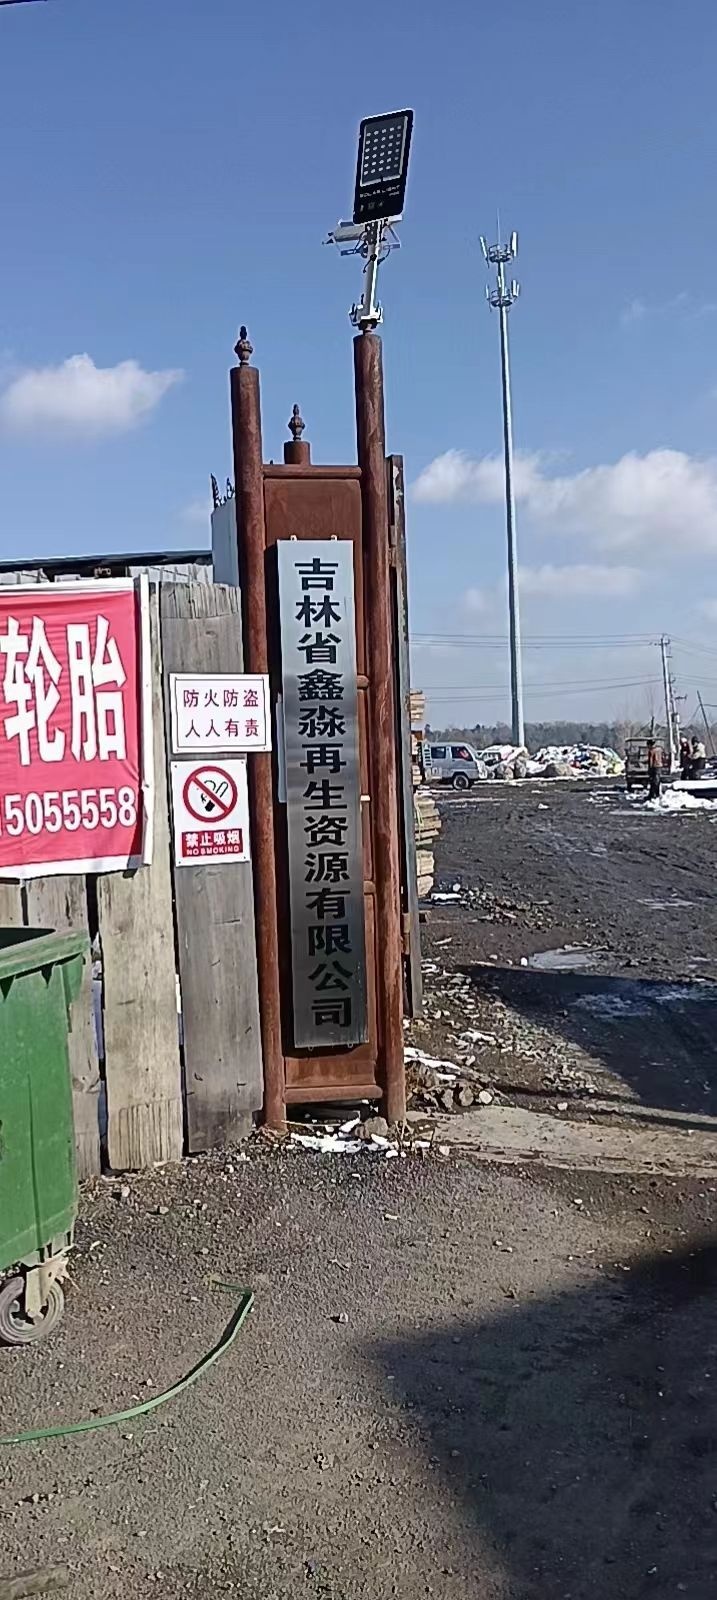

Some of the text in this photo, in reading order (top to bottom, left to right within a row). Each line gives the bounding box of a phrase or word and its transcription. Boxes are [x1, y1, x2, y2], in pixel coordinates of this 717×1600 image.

[0, 615, 127, 766] 轮胎
[183, 688, 259, 708] 防火防盗
[185, 718, 259, 738] 人人有责
[295, 558, 353, 1028] 吉林省鑫淼再生资源有限公司
[0, 785, 137, 836] 5055558
[185, 830, 241, 848] 禁止吸烟
[186, 845, 240, 856] NO SMOKING
